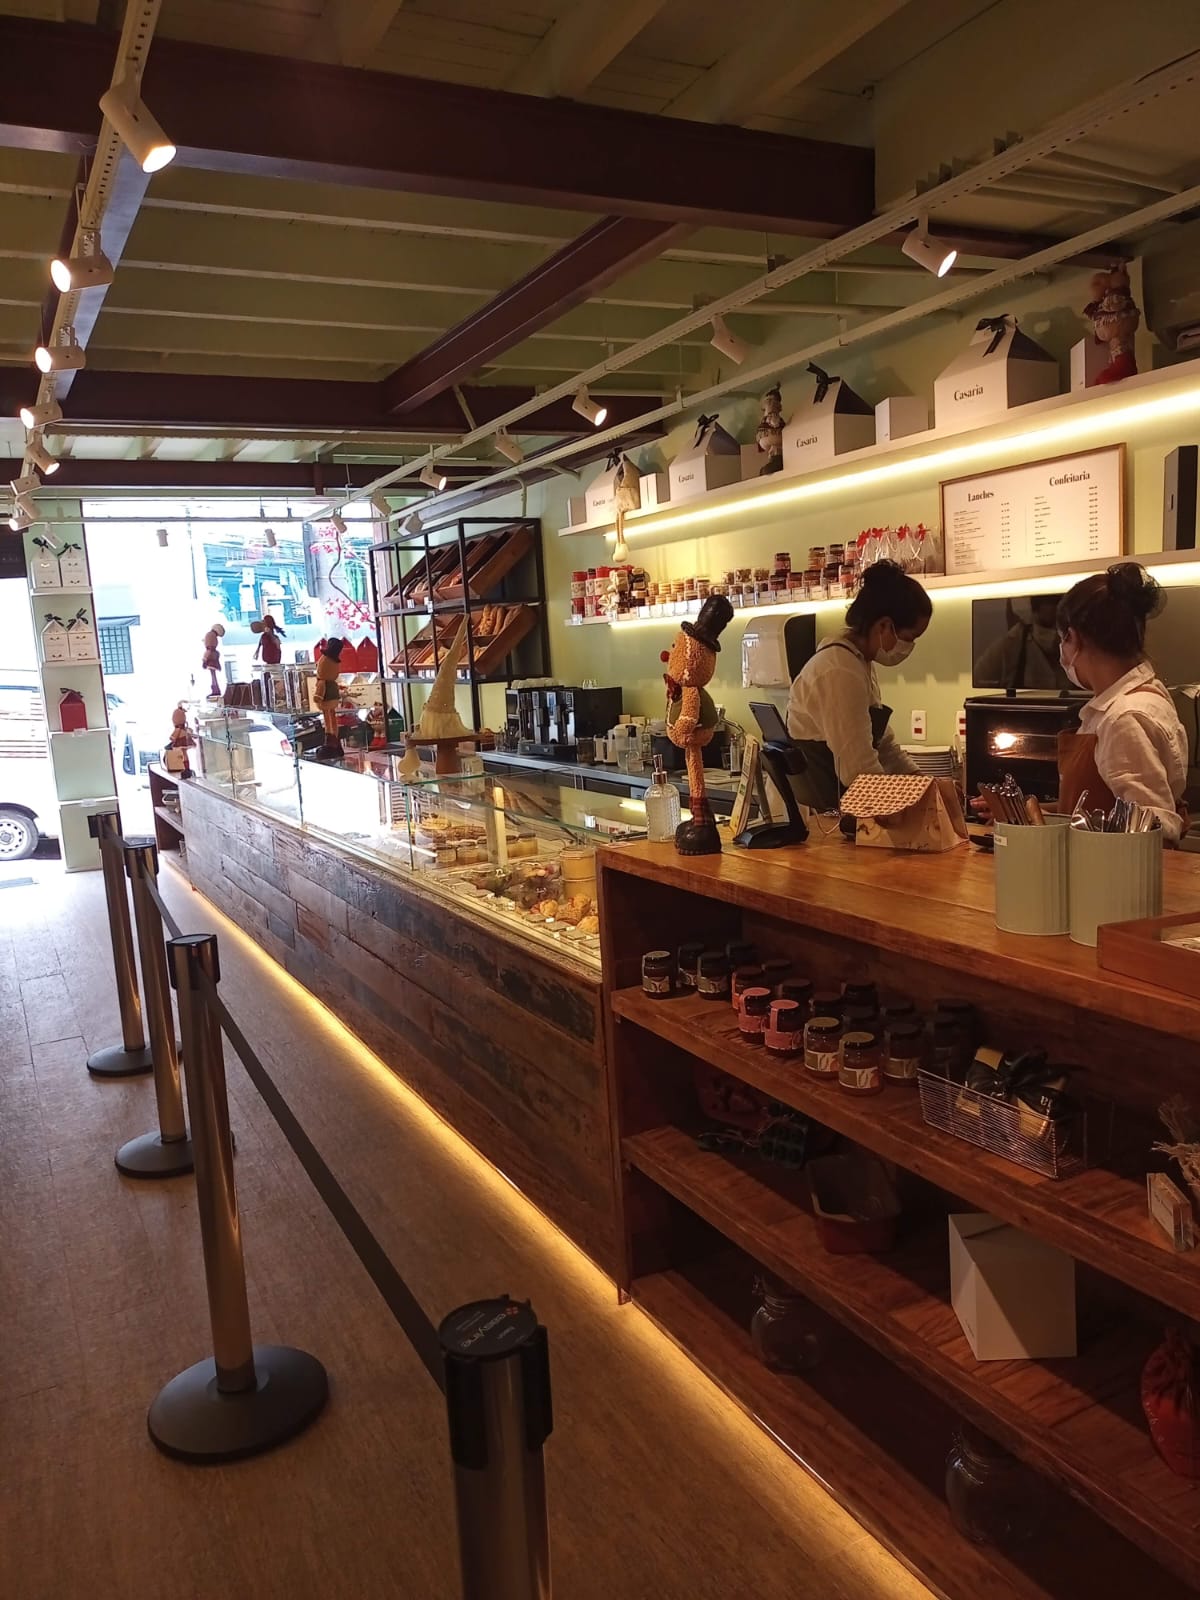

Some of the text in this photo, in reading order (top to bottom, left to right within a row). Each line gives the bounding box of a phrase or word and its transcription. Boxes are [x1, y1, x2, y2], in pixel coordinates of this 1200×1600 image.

[954, 384, 984, 401] Casaria
[796, 434, 818, 449] Casaria
[1049, 470, 1090, 487] Confeitaria
[967, 490, 994, 503] Lanches
